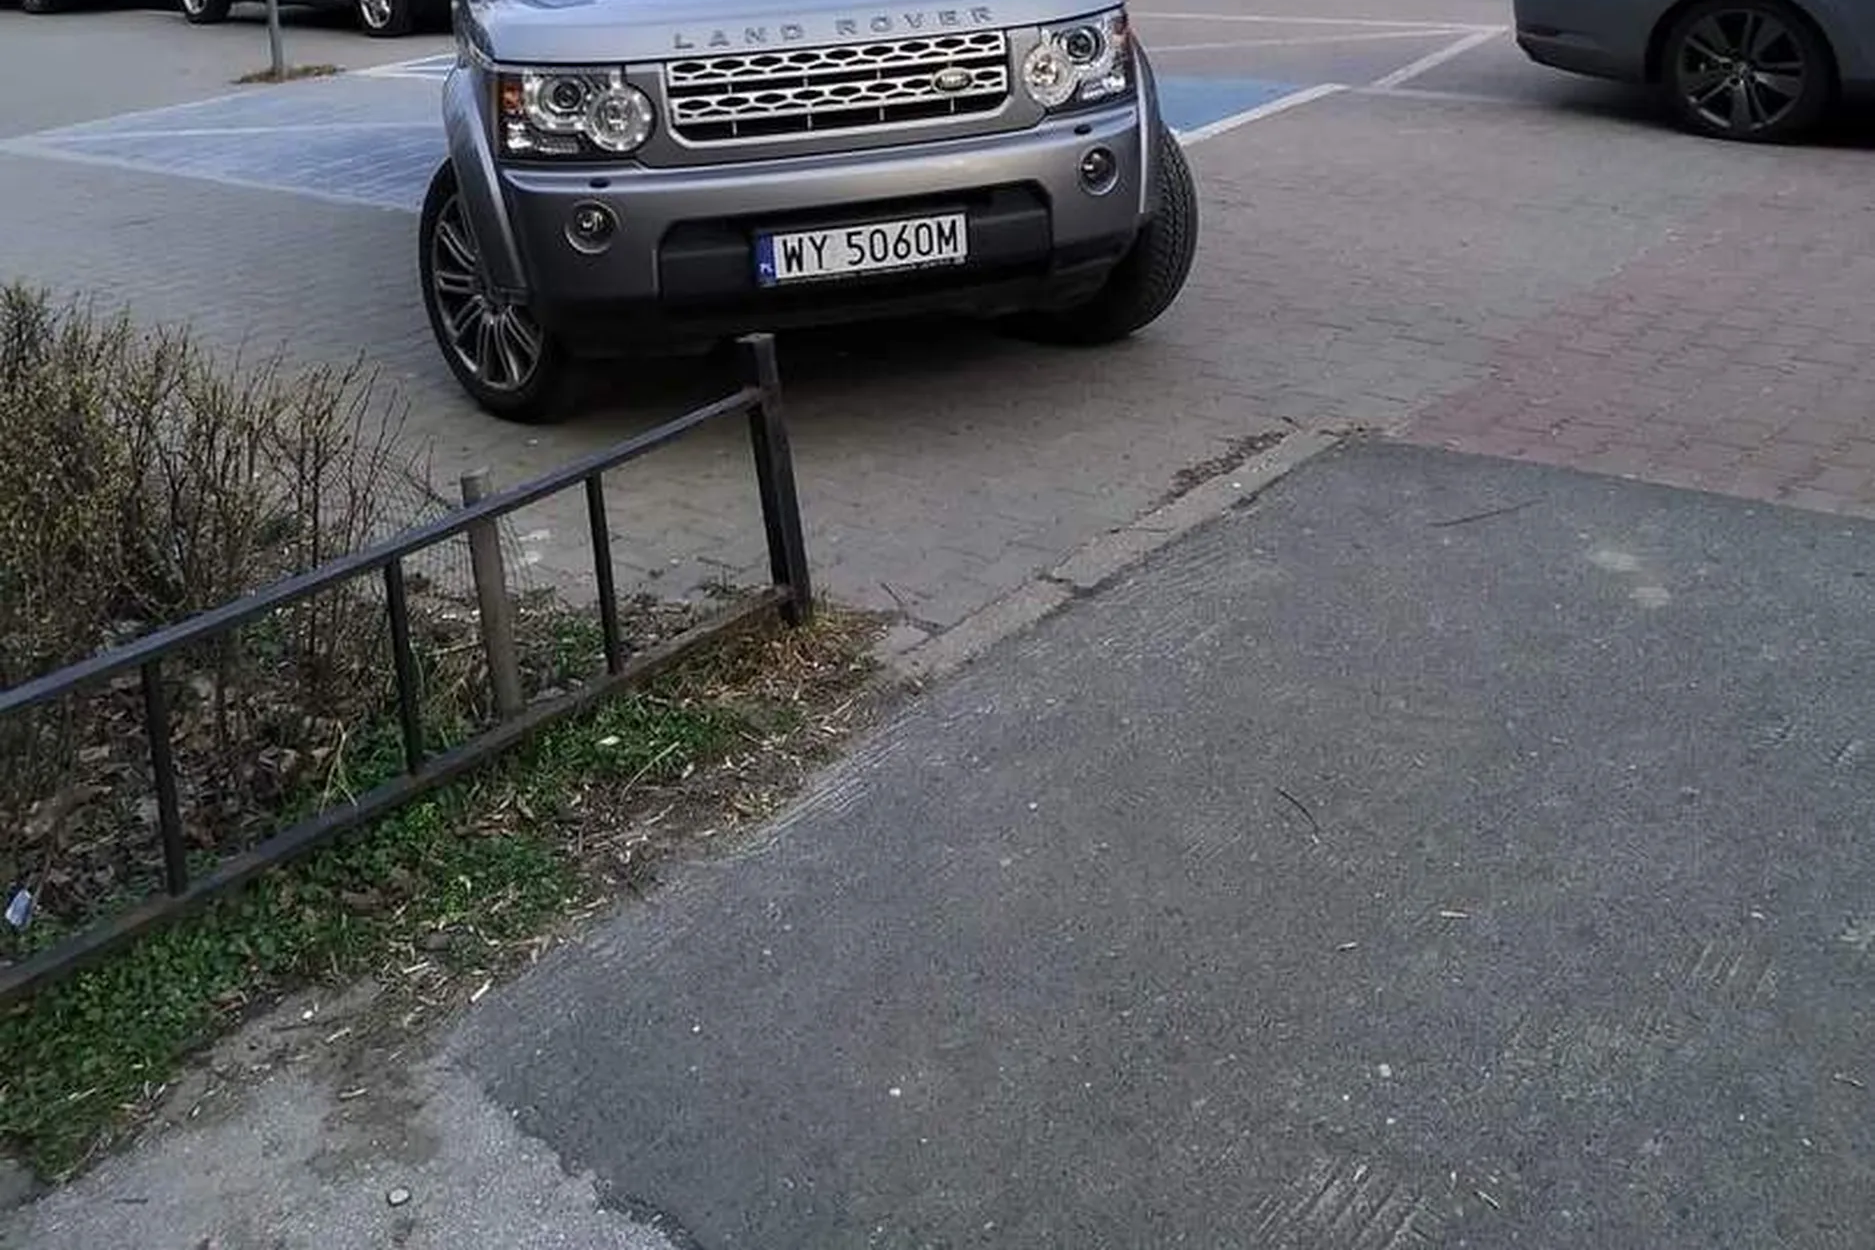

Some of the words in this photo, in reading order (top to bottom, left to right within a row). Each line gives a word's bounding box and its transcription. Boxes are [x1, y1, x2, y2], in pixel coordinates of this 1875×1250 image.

[674, 24, 804, 49] LAND
[835, 6, 994, 36] ROVER
[782, 234, 828, 273] WY
[845, 219, 958, 266] 5060M
